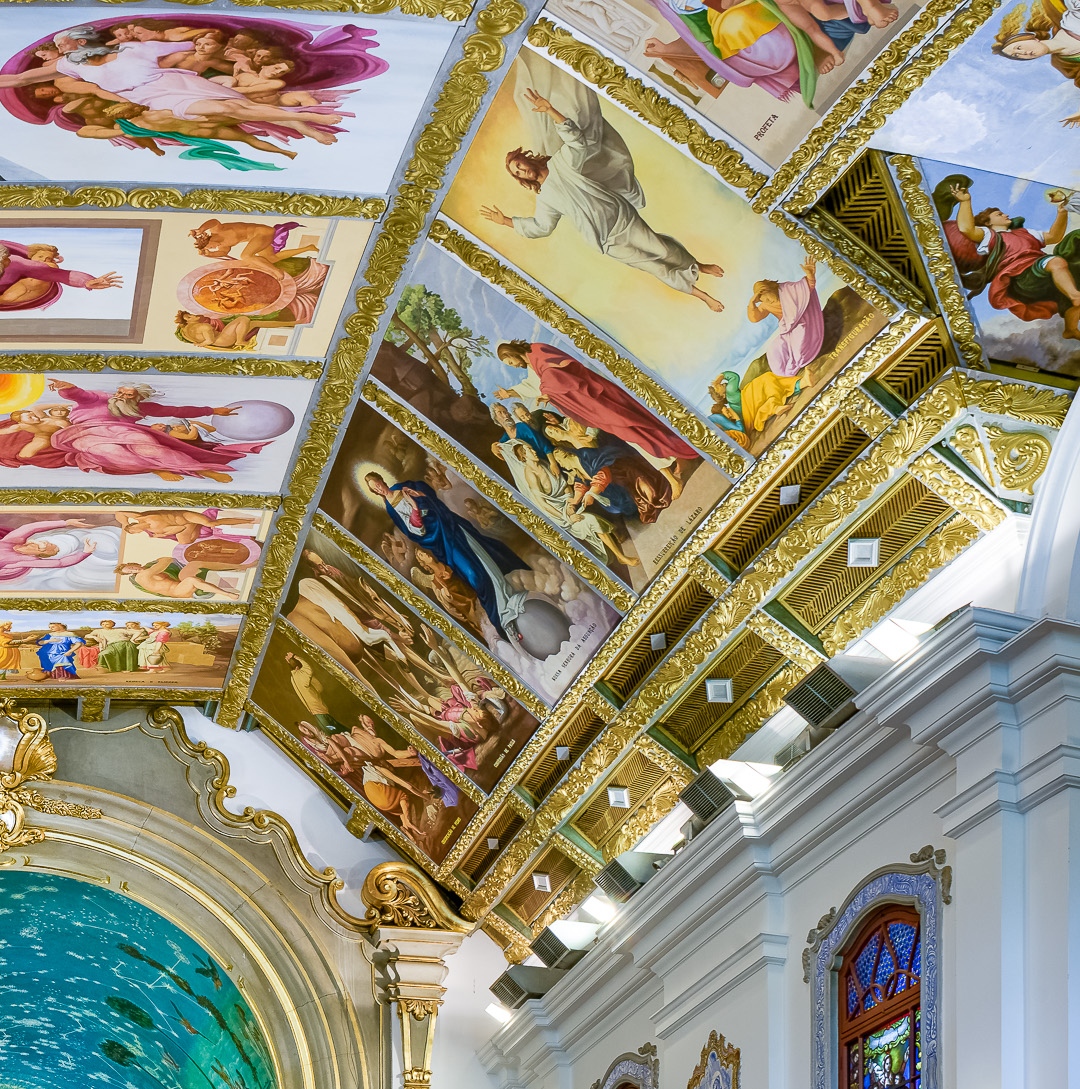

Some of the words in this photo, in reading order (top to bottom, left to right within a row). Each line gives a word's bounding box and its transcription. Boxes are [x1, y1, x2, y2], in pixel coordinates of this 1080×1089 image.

[753, 113, 779, 141] PROFETA
[828, 312, 875, 360] TRANSFIGURAÇÃO
[686, 506, 703, 525] LÁZARO
